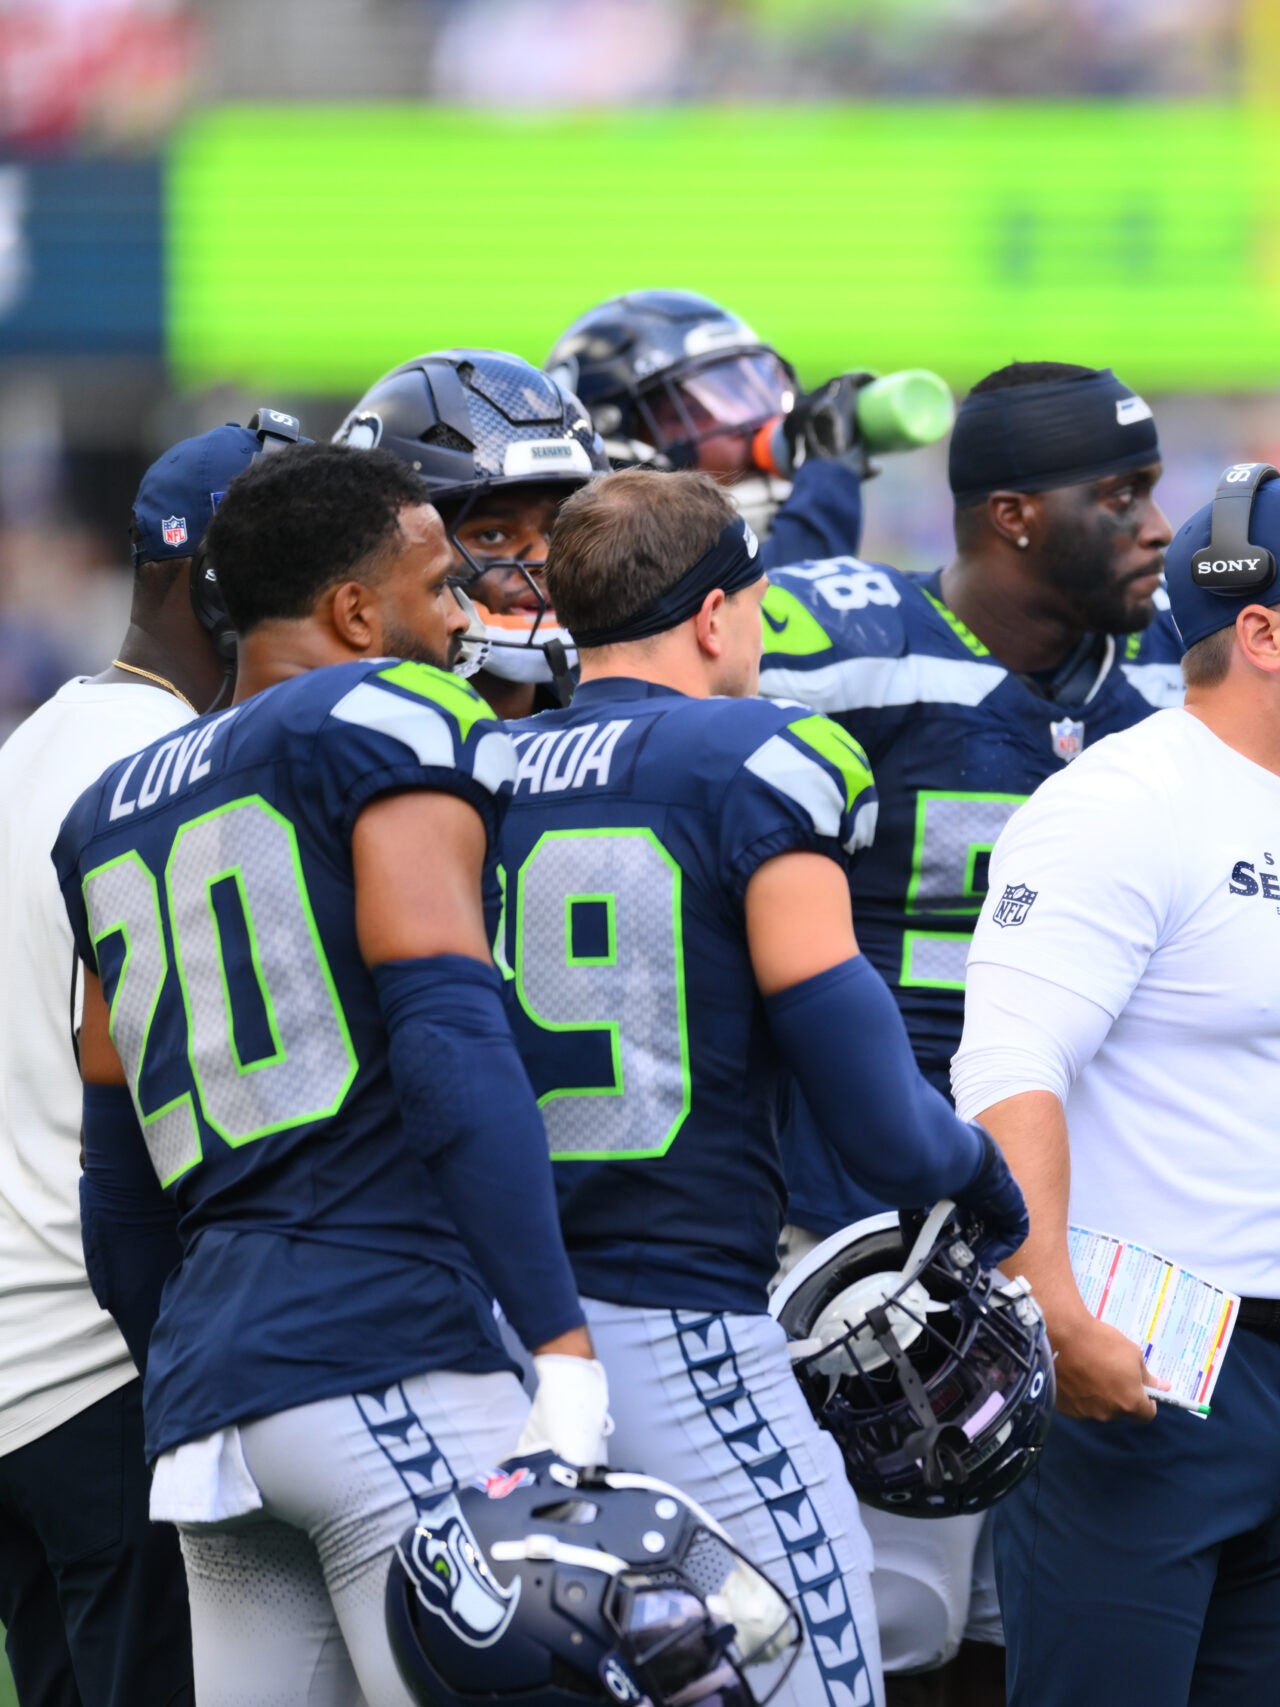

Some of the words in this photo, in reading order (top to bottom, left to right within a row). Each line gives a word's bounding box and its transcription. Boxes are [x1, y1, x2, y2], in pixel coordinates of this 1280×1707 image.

[166, 528, 185, 543] NFL
[1197, 558, 1261, 575] SONY
[109, 706, 241, 822] LOVE
[995, 900, 1024, 923] NFL
[81, 793, 359, 1190] 20
[493, 827, 692, 1161] 9
